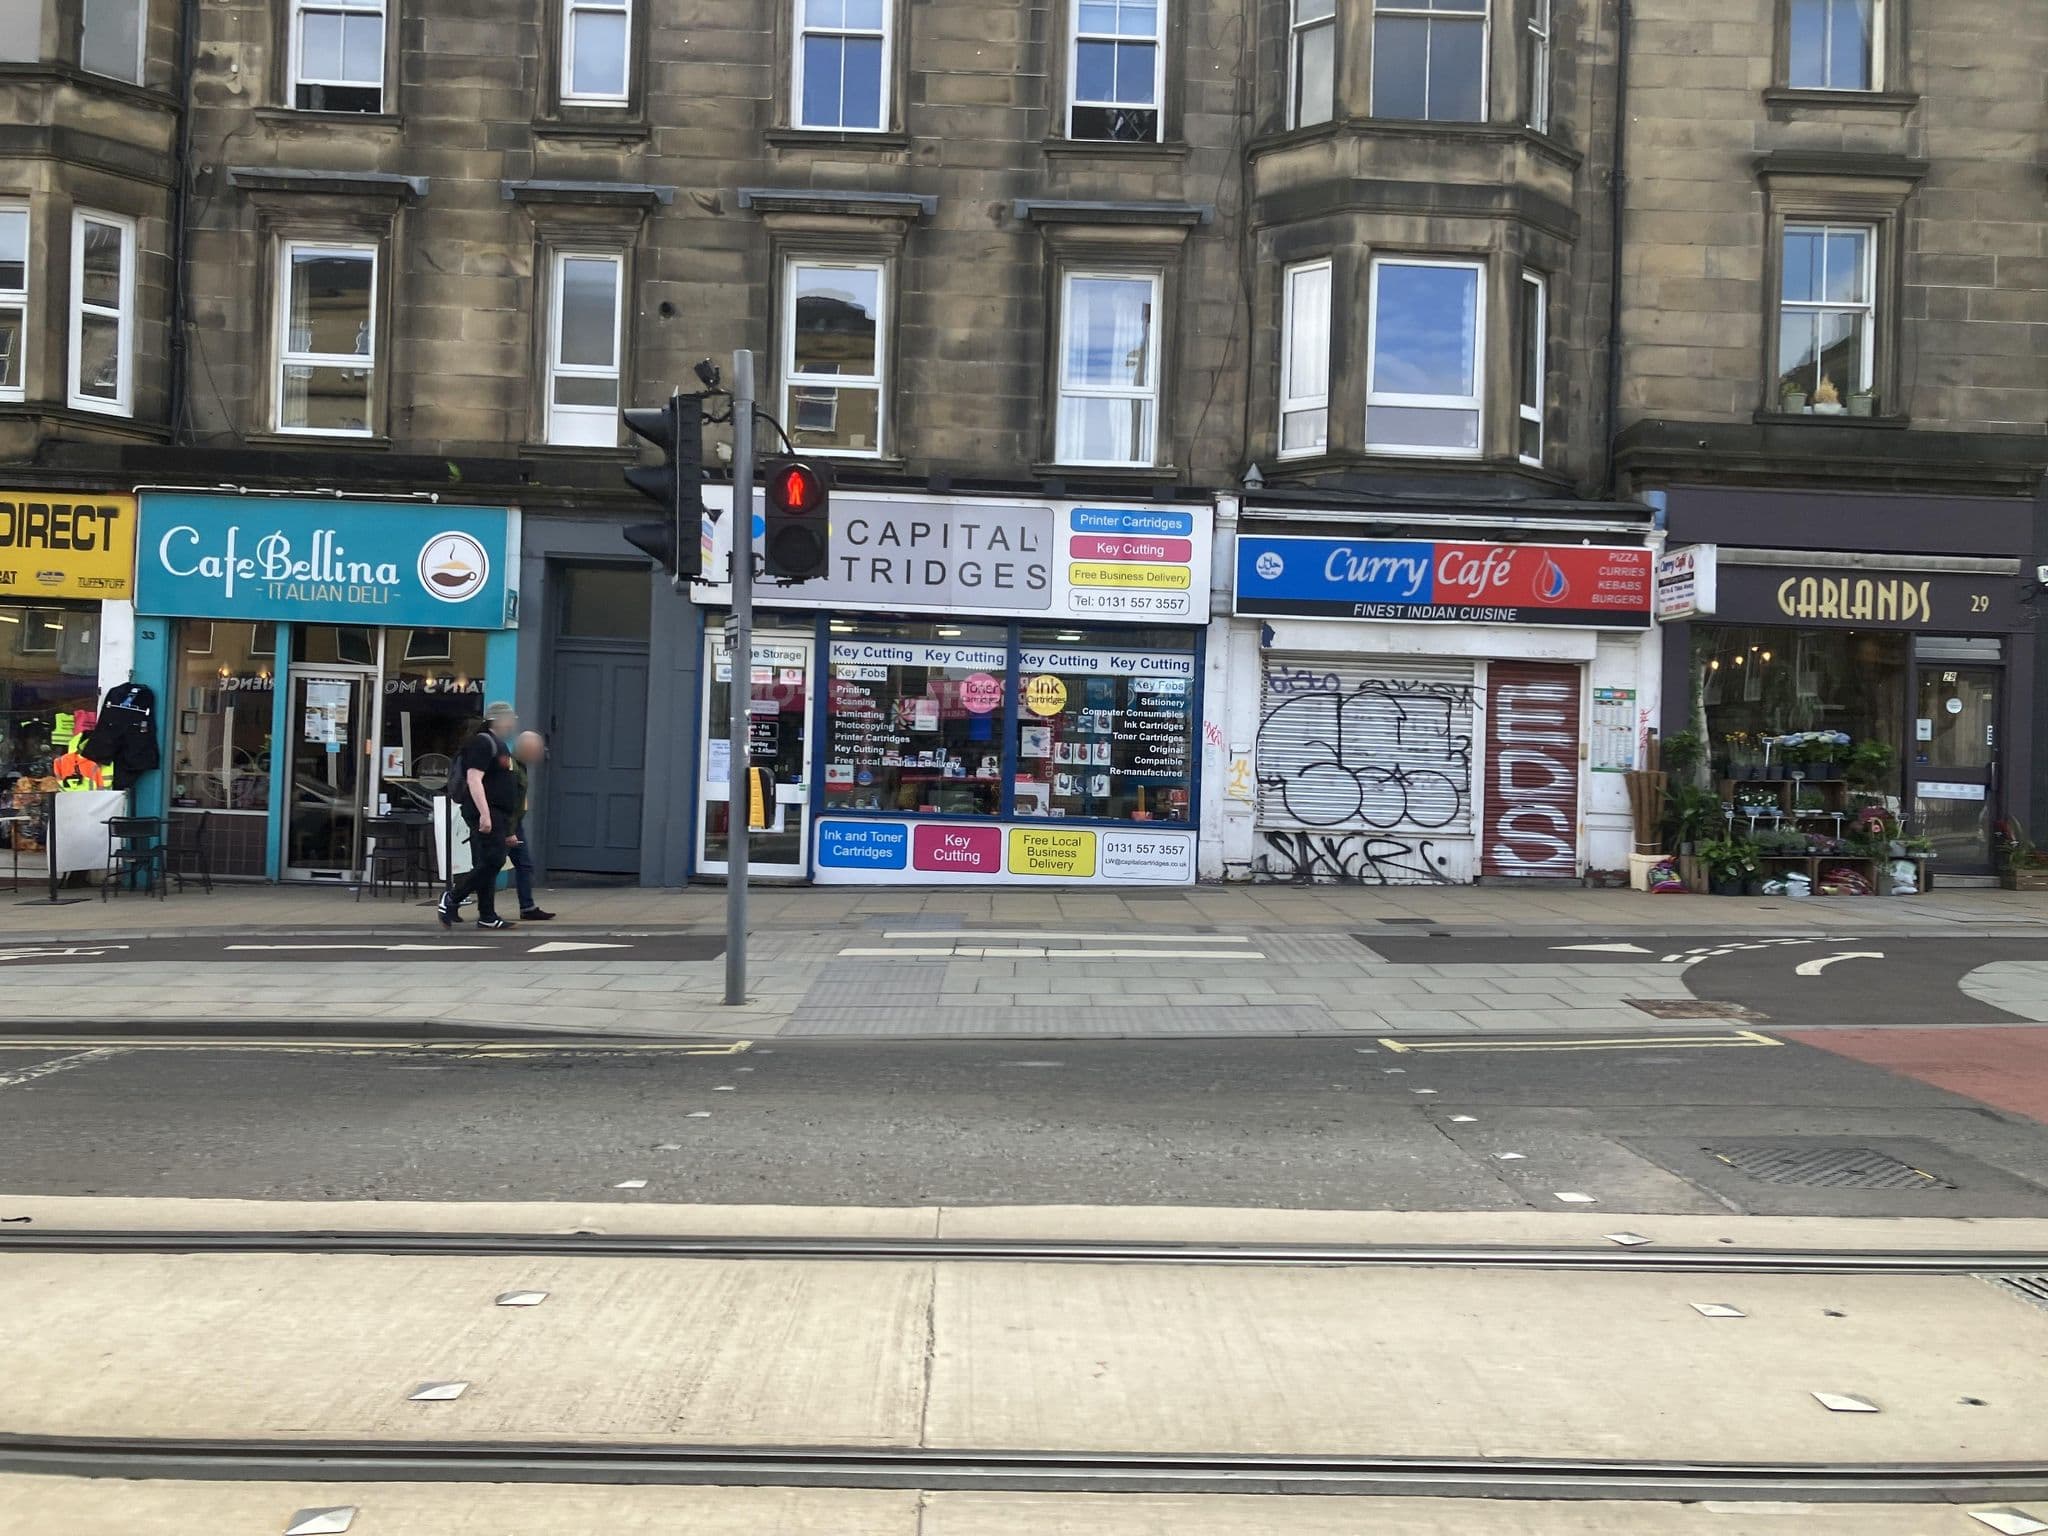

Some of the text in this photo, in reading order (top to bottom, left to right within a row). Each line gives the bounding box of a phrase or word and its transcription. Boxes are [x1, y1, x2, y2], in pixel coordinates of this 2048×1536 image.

[1080, 514, 1183, 531] Printer Cartridges
[846, 519, 1037, 552] CAPITAL
[1097, 542, 1164, 557] Key Cutting
[159, 525, 400, 598] Cafe Bellina
[1609, 552, 1639, 563] PIZZA
[1074, 569, 1186, 584] Free Business Delivery
[1324, 547, 1517, 599] Curry Café
[1599, 566, 1645, 577] CURRIES
[1598, 580, 1641, 590] KEBABS
[268, 583, 388, 604] ITALIAN DELI
[1592, 593, 1644, 604] BURGERS
[1777, 576, 1931, 622] GARLANDS
[1075, 595, 1185, 609] Tel: 0131 557 3557
[1971, 594, 1990, 612] 29
[1354, 603, 1518, 621] FINEST INDIAN CUISINE
[141, 630, 155, 640] 33
[762, 649, 802, 661] Storage
[833, 645, 1004, 665] Key Cutting Key Cutting
[1019, 653, 1190, 672] Key Cutting Key Cutting
[837, 668, 886, 679] Key Fobs
[1944, 672, 1956, 681] 29
[836, 685, 870, 696] Printing
[964, 681, 998, 694] Toner
[1036, 679, 1060, 694] Ink
[1135, 679, 1184, 691] Key Fobs
[836, 698, 876, 708] Scanning
[1027, 695, 1065, 705] Cartridges
[1141, 698, 1184, 708] Stationery
[836, 710, 884, 720] Laminating
[1082, 707, 1184, 719] Computer Consumables
[835, 721, 894, 732] Photocopying
[1124, 721, 1184, 731] Ink Cartridges
[834, 733, 910, 744] Printer Cartridges
[1113, 732, 1183, 743] Toner Cartridges
[834, 745, 884, 755] Key Cutting
[1149, 745, 1184, 754] Original
[856, 757, 880, 766] Local
[1134, 756, 1183, 766] Compatible
[1110, 767, 1183, 777] Re-manufactured
[825, 829, 903, 843] Ink and Toner
[945, 834, 971, 849] Key
[1023, 835, 1081, 847] Free Local
[833, 845, 893, 859] Cartridges
[1027, 846, 1077, 858] Business
[1107, 842, 1185, 855] 0131 557 3557
[934, 849, 981, 864] Cutting
[1029, 858, 1074, 872] Delivery
